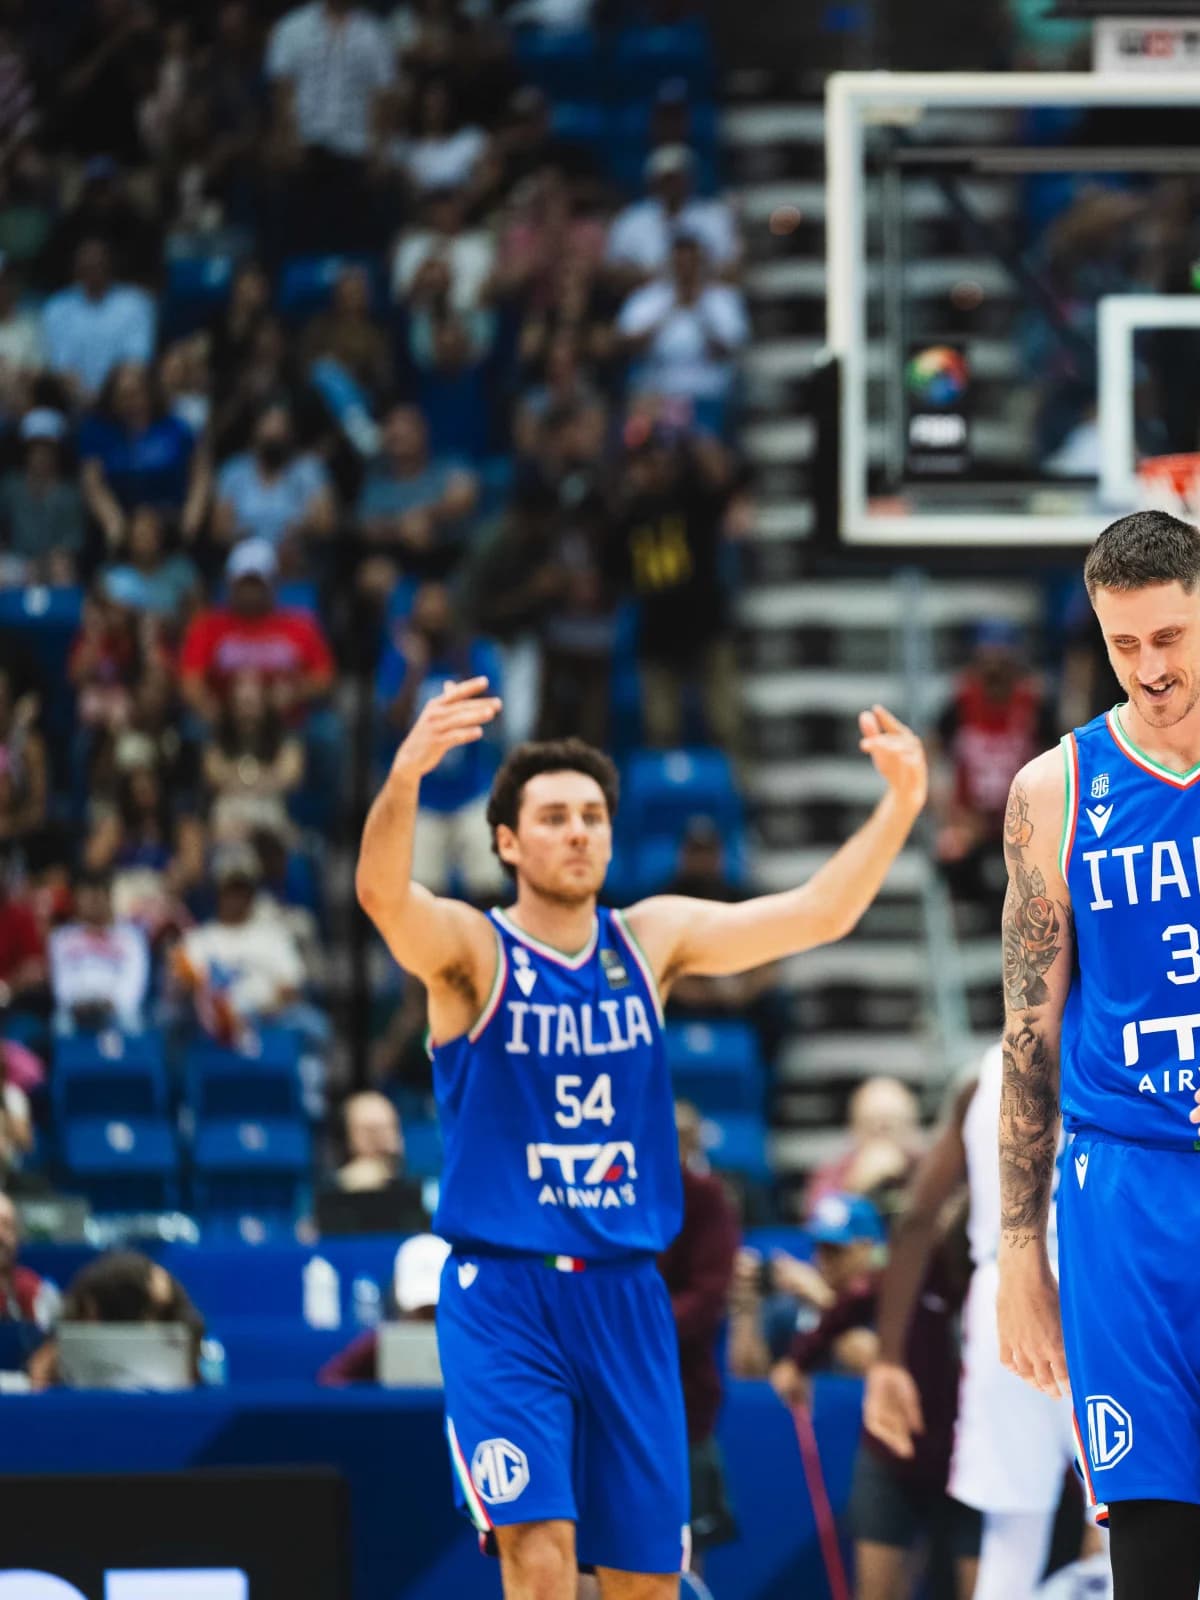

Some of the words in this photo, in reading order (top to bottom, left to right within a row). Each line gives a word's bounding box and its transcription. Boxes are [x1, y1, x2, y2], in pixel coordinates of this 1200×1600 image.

[505, 996, 653, 1056] ITALIA
[555, 1073, 616, 1129] 54
[526, 1141, 638, 1185] ITA
[472, 1439, 529, 1503] MG
